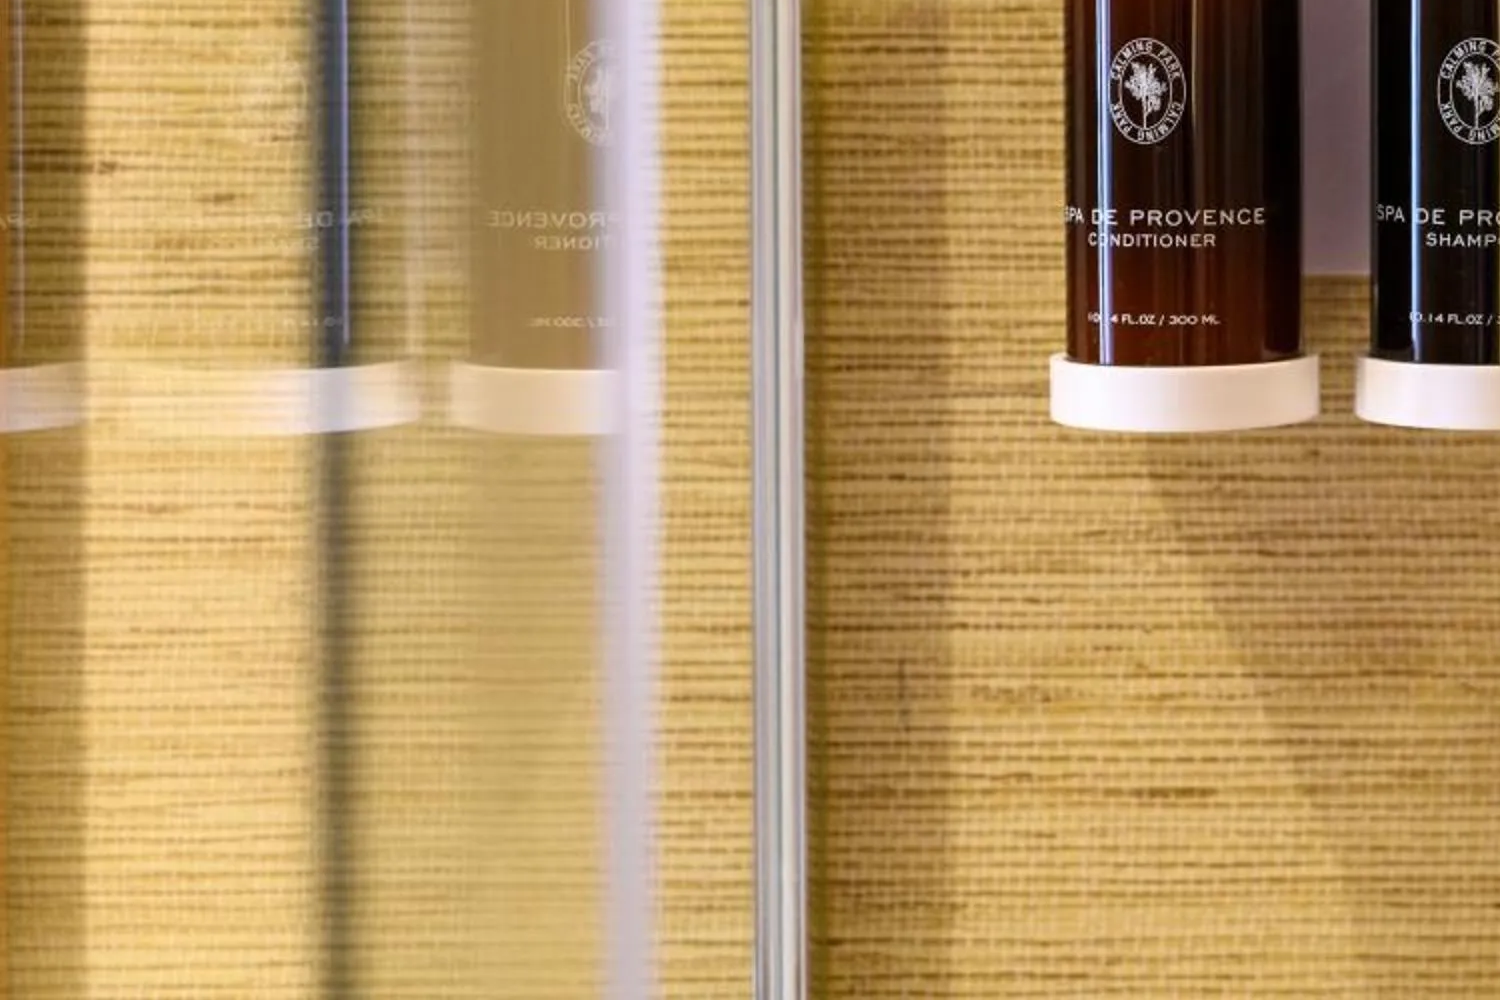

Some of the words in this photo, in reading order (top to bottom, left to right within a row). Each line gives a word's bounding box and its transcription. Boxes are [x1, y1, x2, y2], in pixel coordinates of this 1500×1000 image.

[1111, 40, 1153, 80] CALMING
[1441, 40, 1487, 79] CALMING
[1091, 208, 1118, 225] DE
[1130, 207, 1266, 226] PROVENCE
[1377, 204, 1406, 223] SPA
[1413, 208, 1446, 225] DE
[1088, 232, 1216, 248] CONDITIONER
[1169, 315, 1198, 325] 300
[1201, 314, 1221, 325] ML
